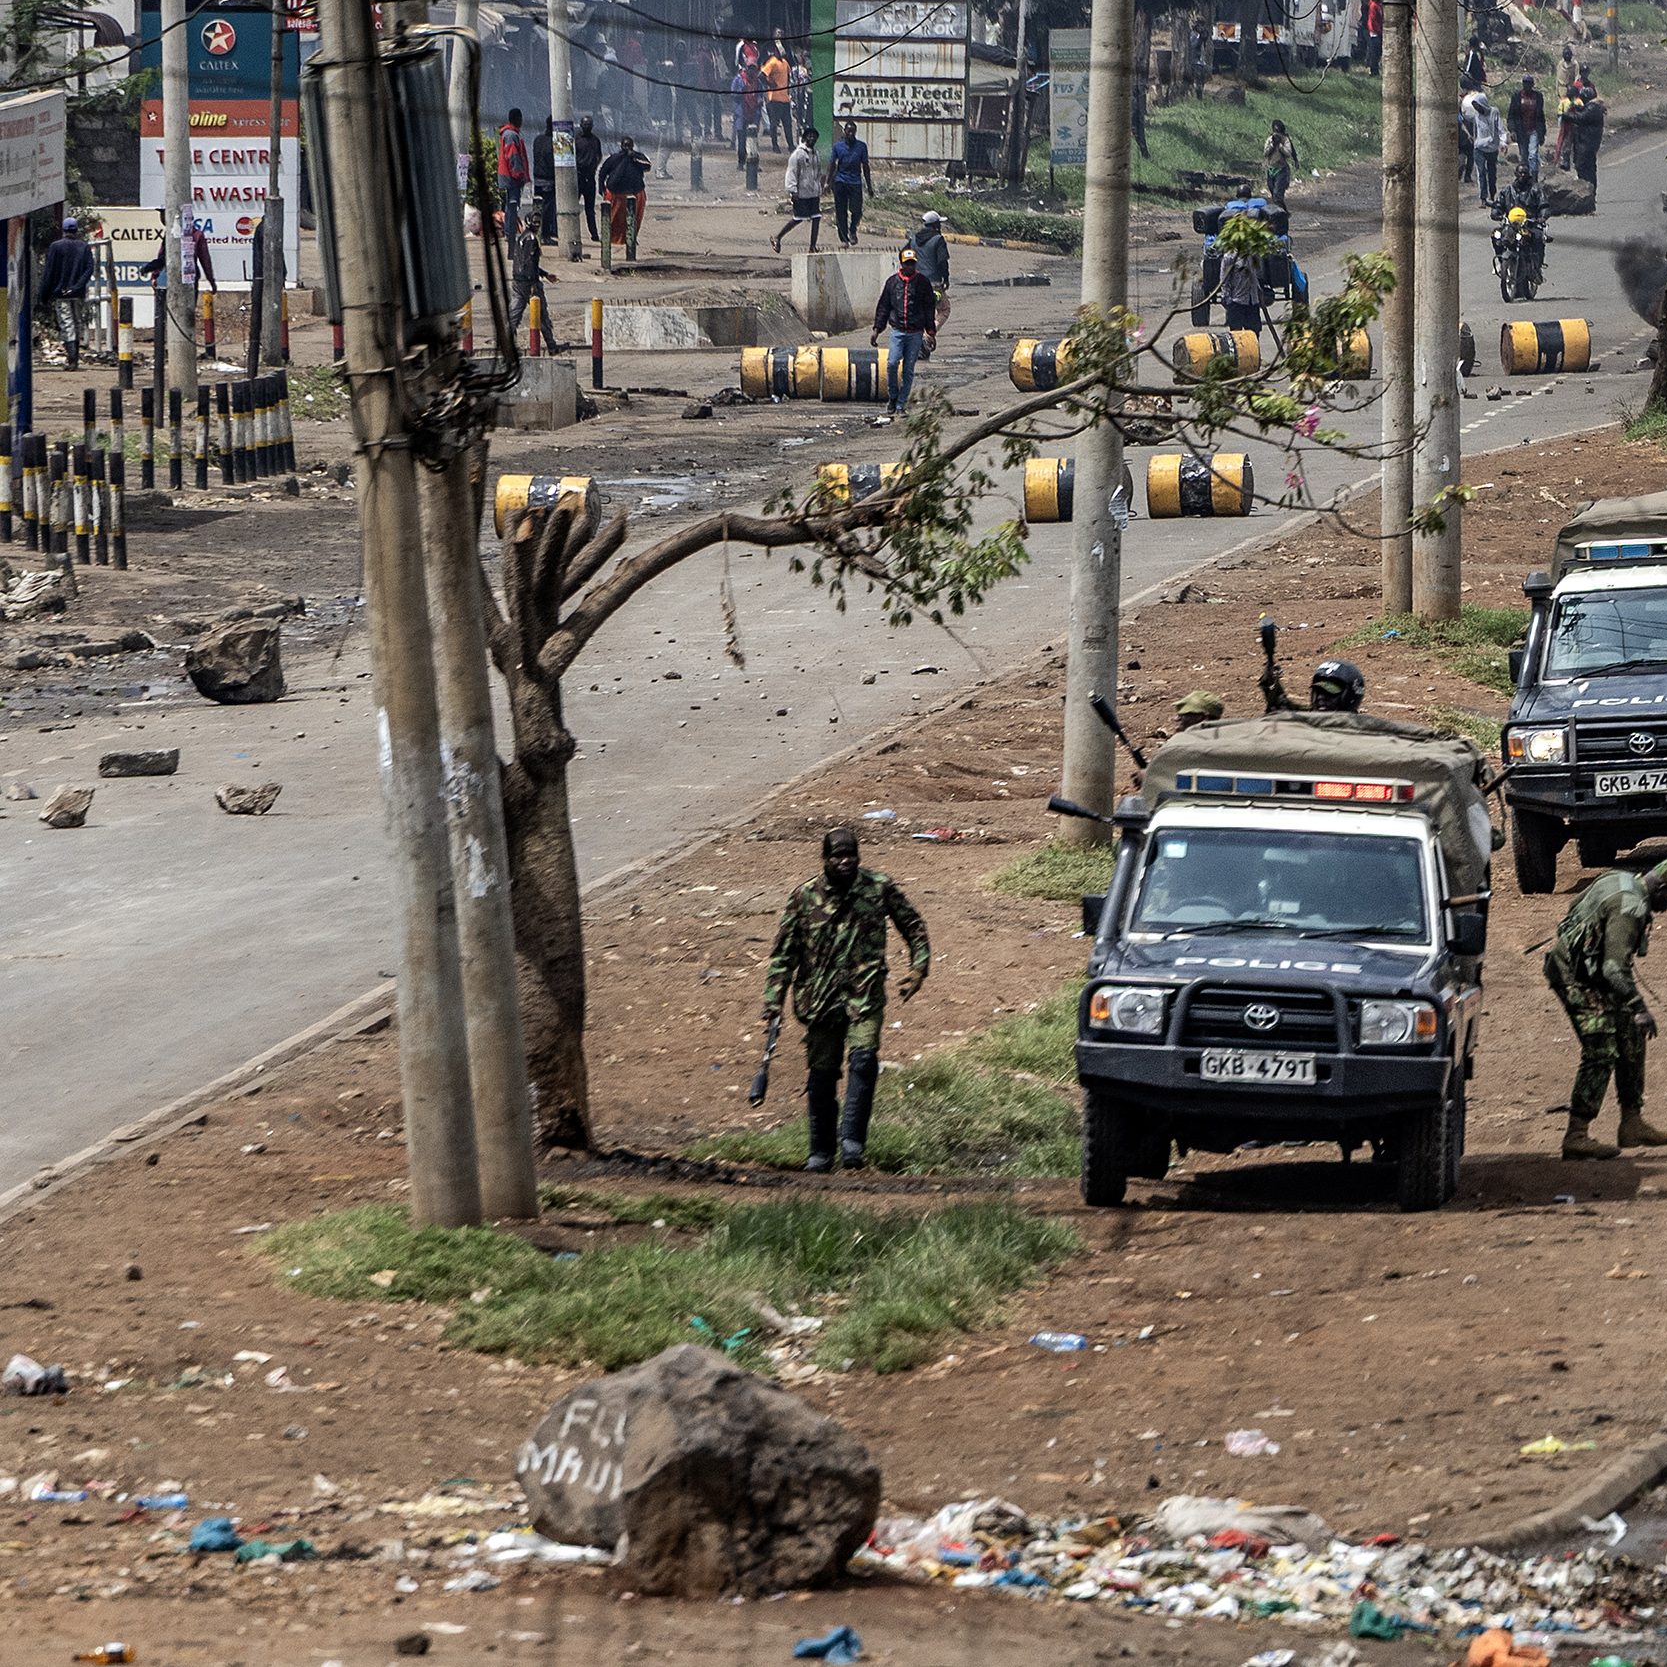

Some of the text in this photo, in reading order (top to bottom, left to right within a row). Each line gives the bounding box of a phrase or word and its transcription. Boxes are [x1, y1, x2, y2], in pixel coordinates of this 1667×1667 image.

[200, 60, 239, 71] CALTEX
[839, 84, 962, 101] Animal Feeds
[1053, 84, 1075, 93] TVS
[867, 98, 888, 106] Raw
[210, 187, 267, 202] WASH
[111, 229, 166, 241] CALTEX
[1174, 957, 1363, 974] POLICE
